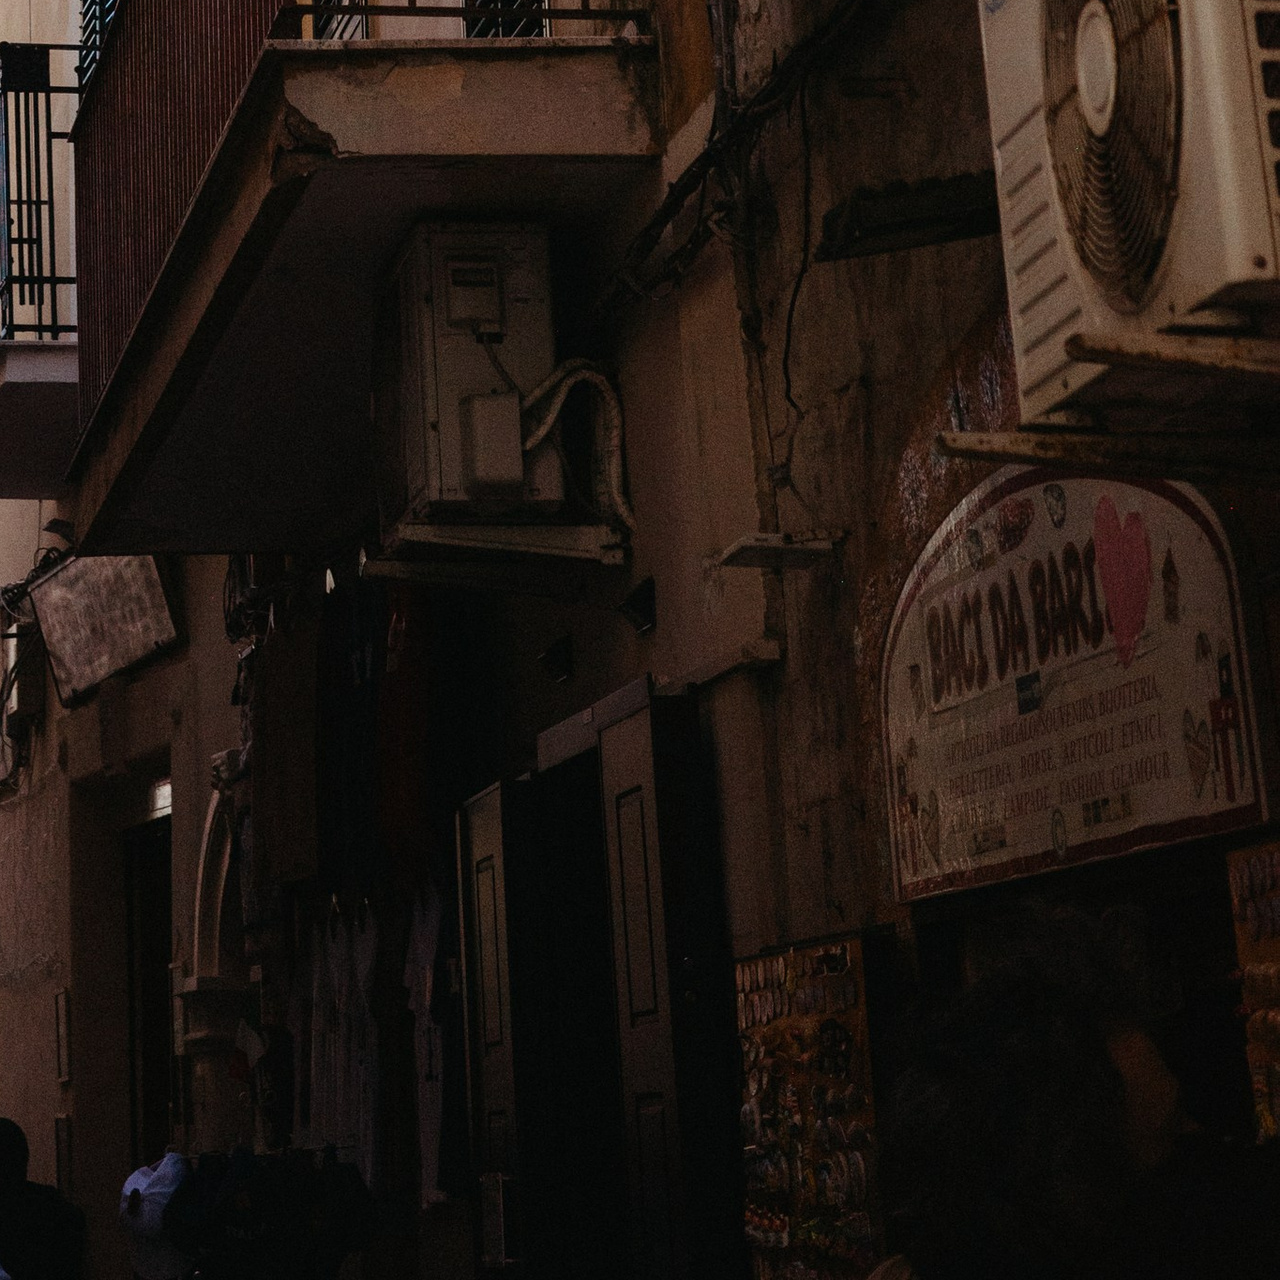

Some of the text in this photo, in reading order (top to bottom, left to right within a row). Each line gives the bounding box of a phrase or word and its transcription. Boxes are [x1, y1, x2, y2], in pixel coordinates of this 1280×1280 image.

[927, 588, 989, 706] BACI
[988, 568, 1030, 682] DA
[1064, 726, 1114, 766] ARTICOLI
[1059, 770, 1105, 805] FASHION
[1111, 751, 1170, 790] GLAMOUR
